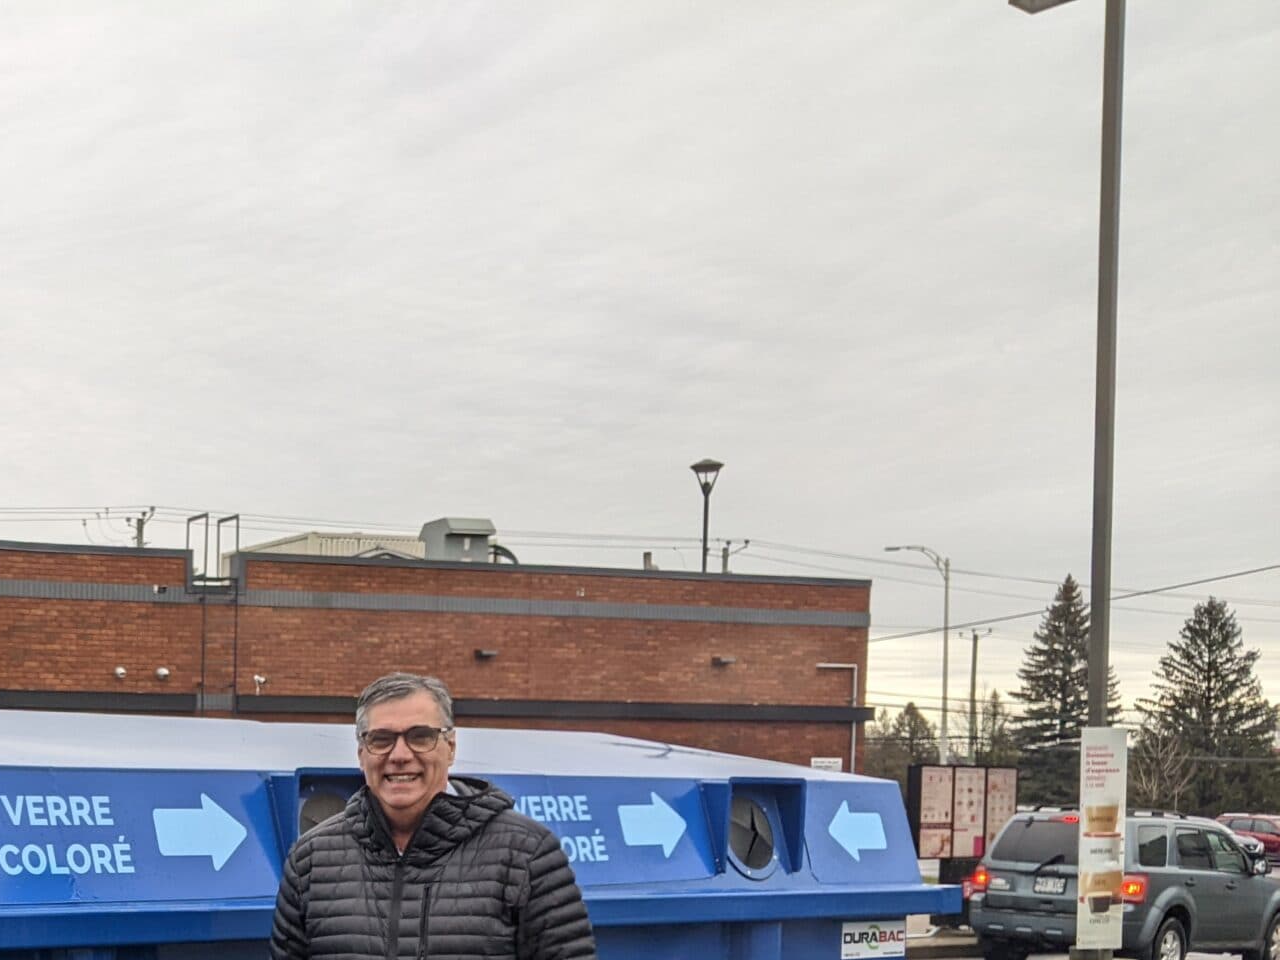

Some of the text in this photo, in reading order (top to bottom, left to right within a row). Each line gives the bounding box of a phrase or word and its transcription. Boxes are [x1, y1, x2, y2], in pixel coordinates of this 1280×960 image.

[0, 795, 114, 826] VERRE
[512, 795, 592, 822] VERRE
[561, 828, 609, 862] ORÉ
[843, 930, 905, 944] DURABAC
